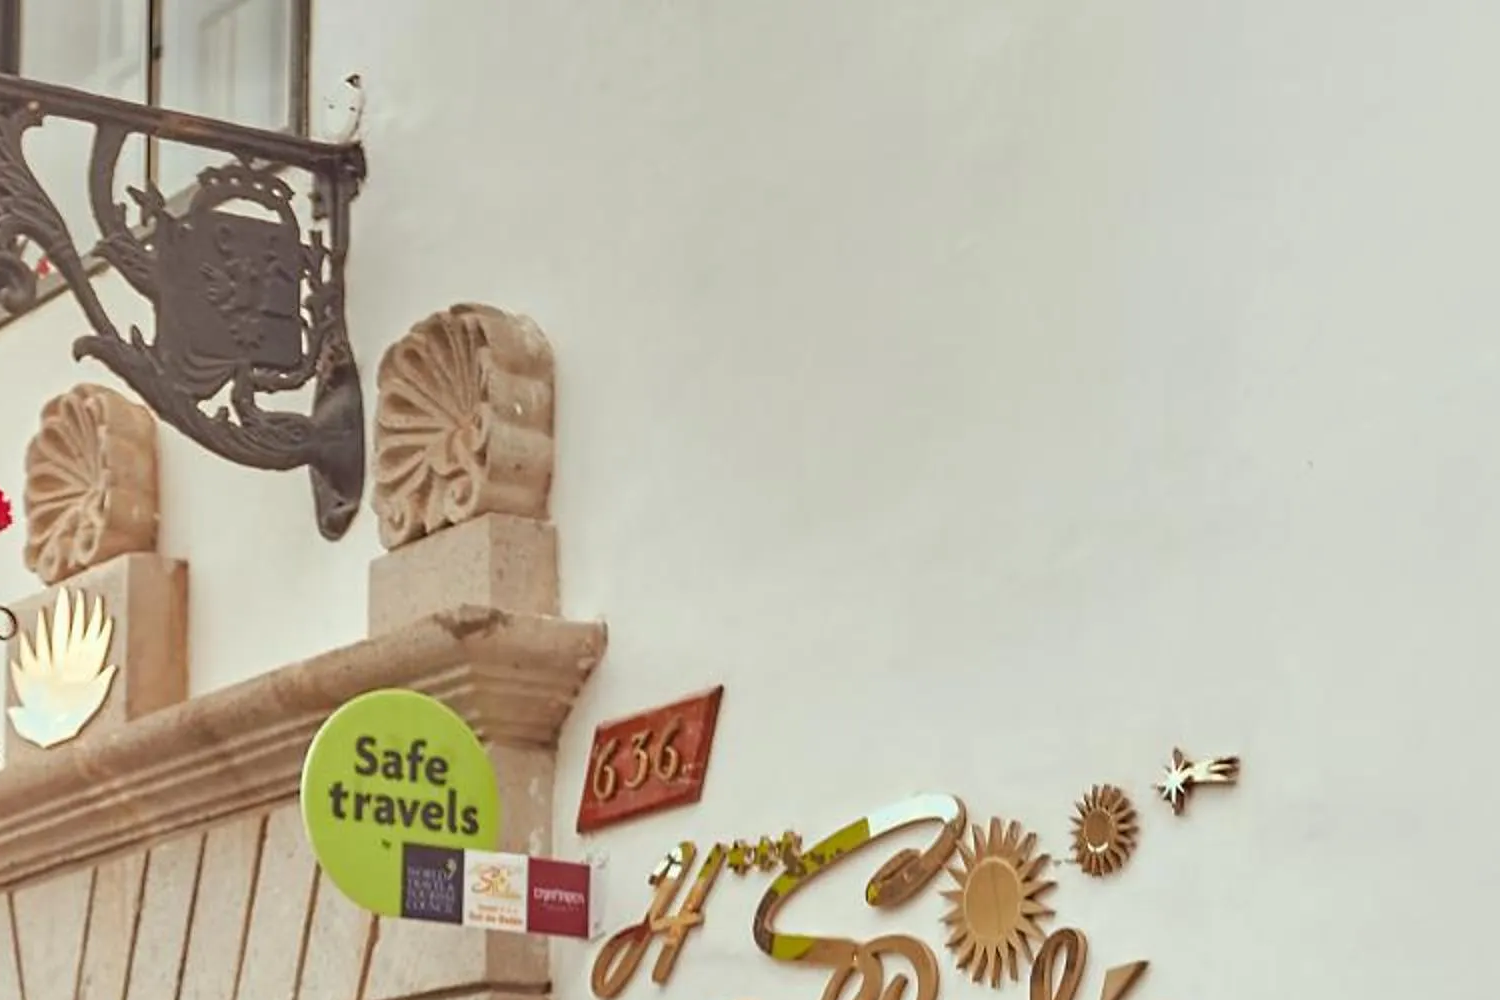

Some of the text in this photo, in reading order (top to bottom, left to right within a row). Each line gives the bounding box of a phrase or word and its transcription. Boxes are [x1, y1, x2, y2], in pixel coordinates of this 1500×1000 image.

[354, 735, 449, 787] Safe
[592, 714, 683, 803] 636
[328, 780, 480, 836] travels
